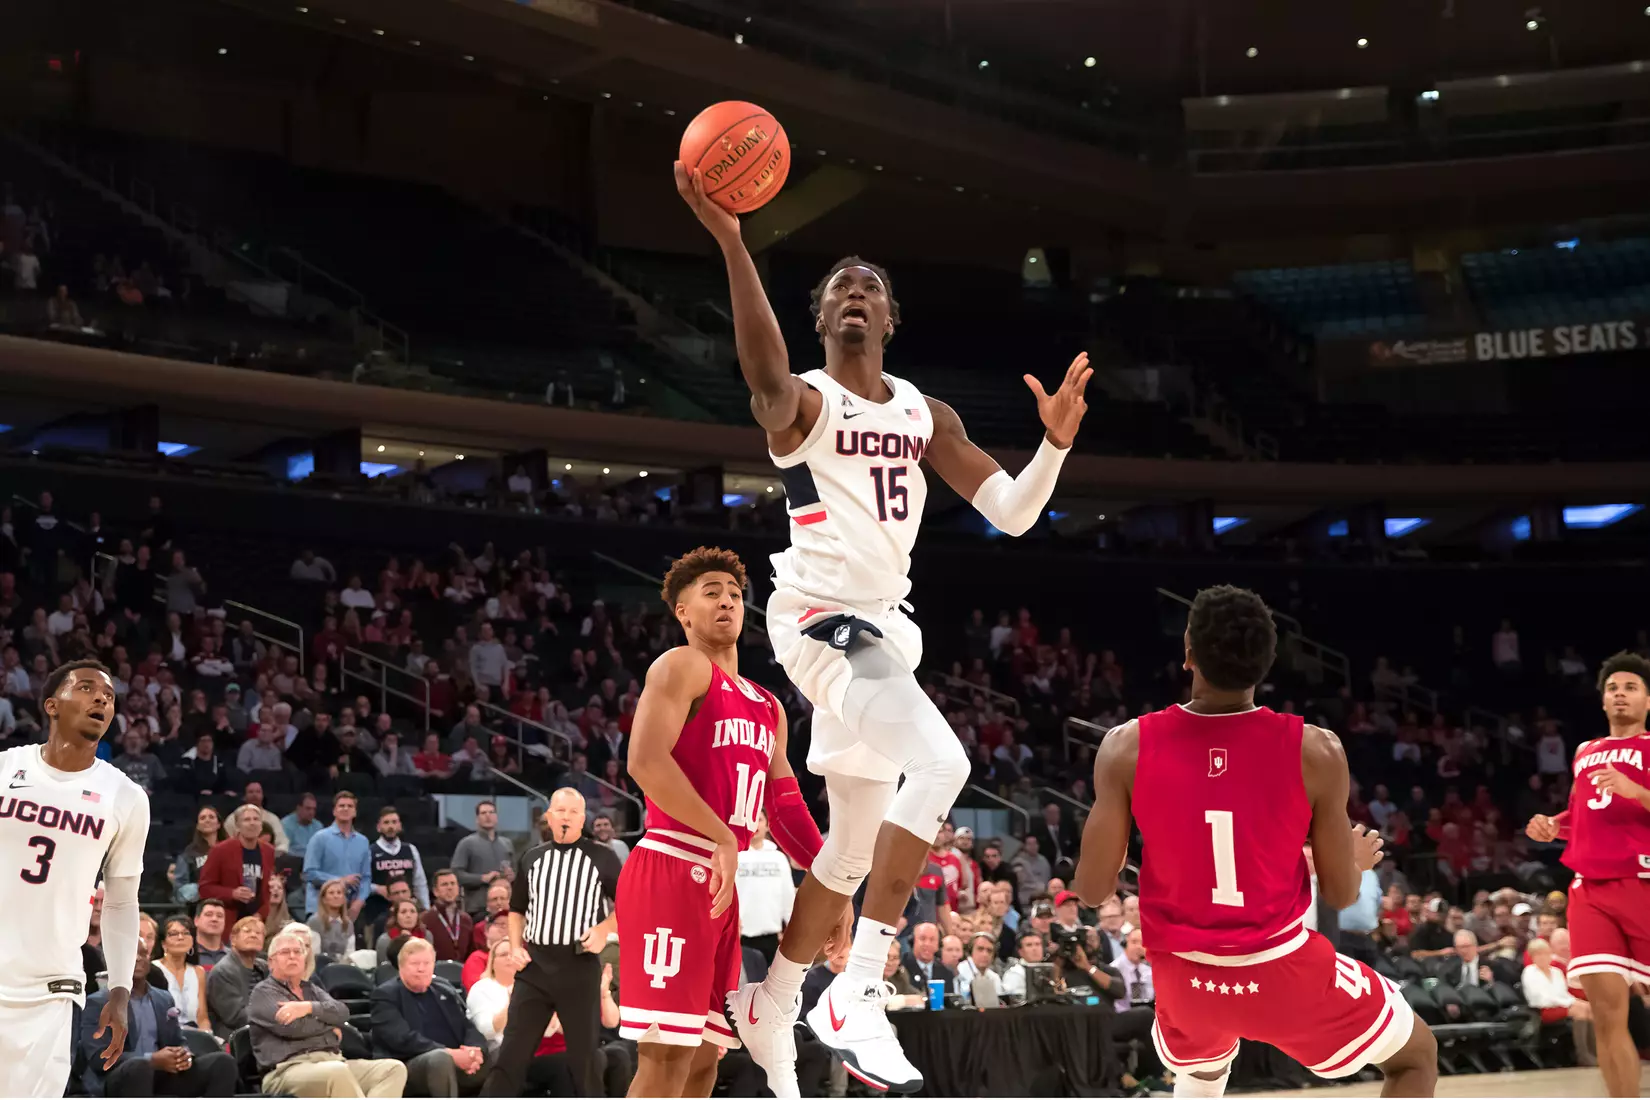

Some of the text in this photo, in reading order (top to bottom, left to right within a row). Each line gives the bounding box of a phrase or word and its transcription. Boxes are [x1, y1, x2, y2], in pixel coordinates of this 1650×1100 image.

[705, 125, 768, 185] SPALDING
[1474, 328, 1546, 361] BLUE
[1552, 320, 1638, 355] SEATS
[835, 430, 929, 461] UCONN
[869, 466, 909, 522] 15
[1574, 748, 1643, 779] INDIANA
[728, 762, 766, 833] 10
[1587, 774, 1613, 810] 3
[0, 796, 105, 840] UCONN
[20, 835, 56, 884] 3
[1204, 810, 1244, 907] 1
[643, 927, 686, 989] IU
